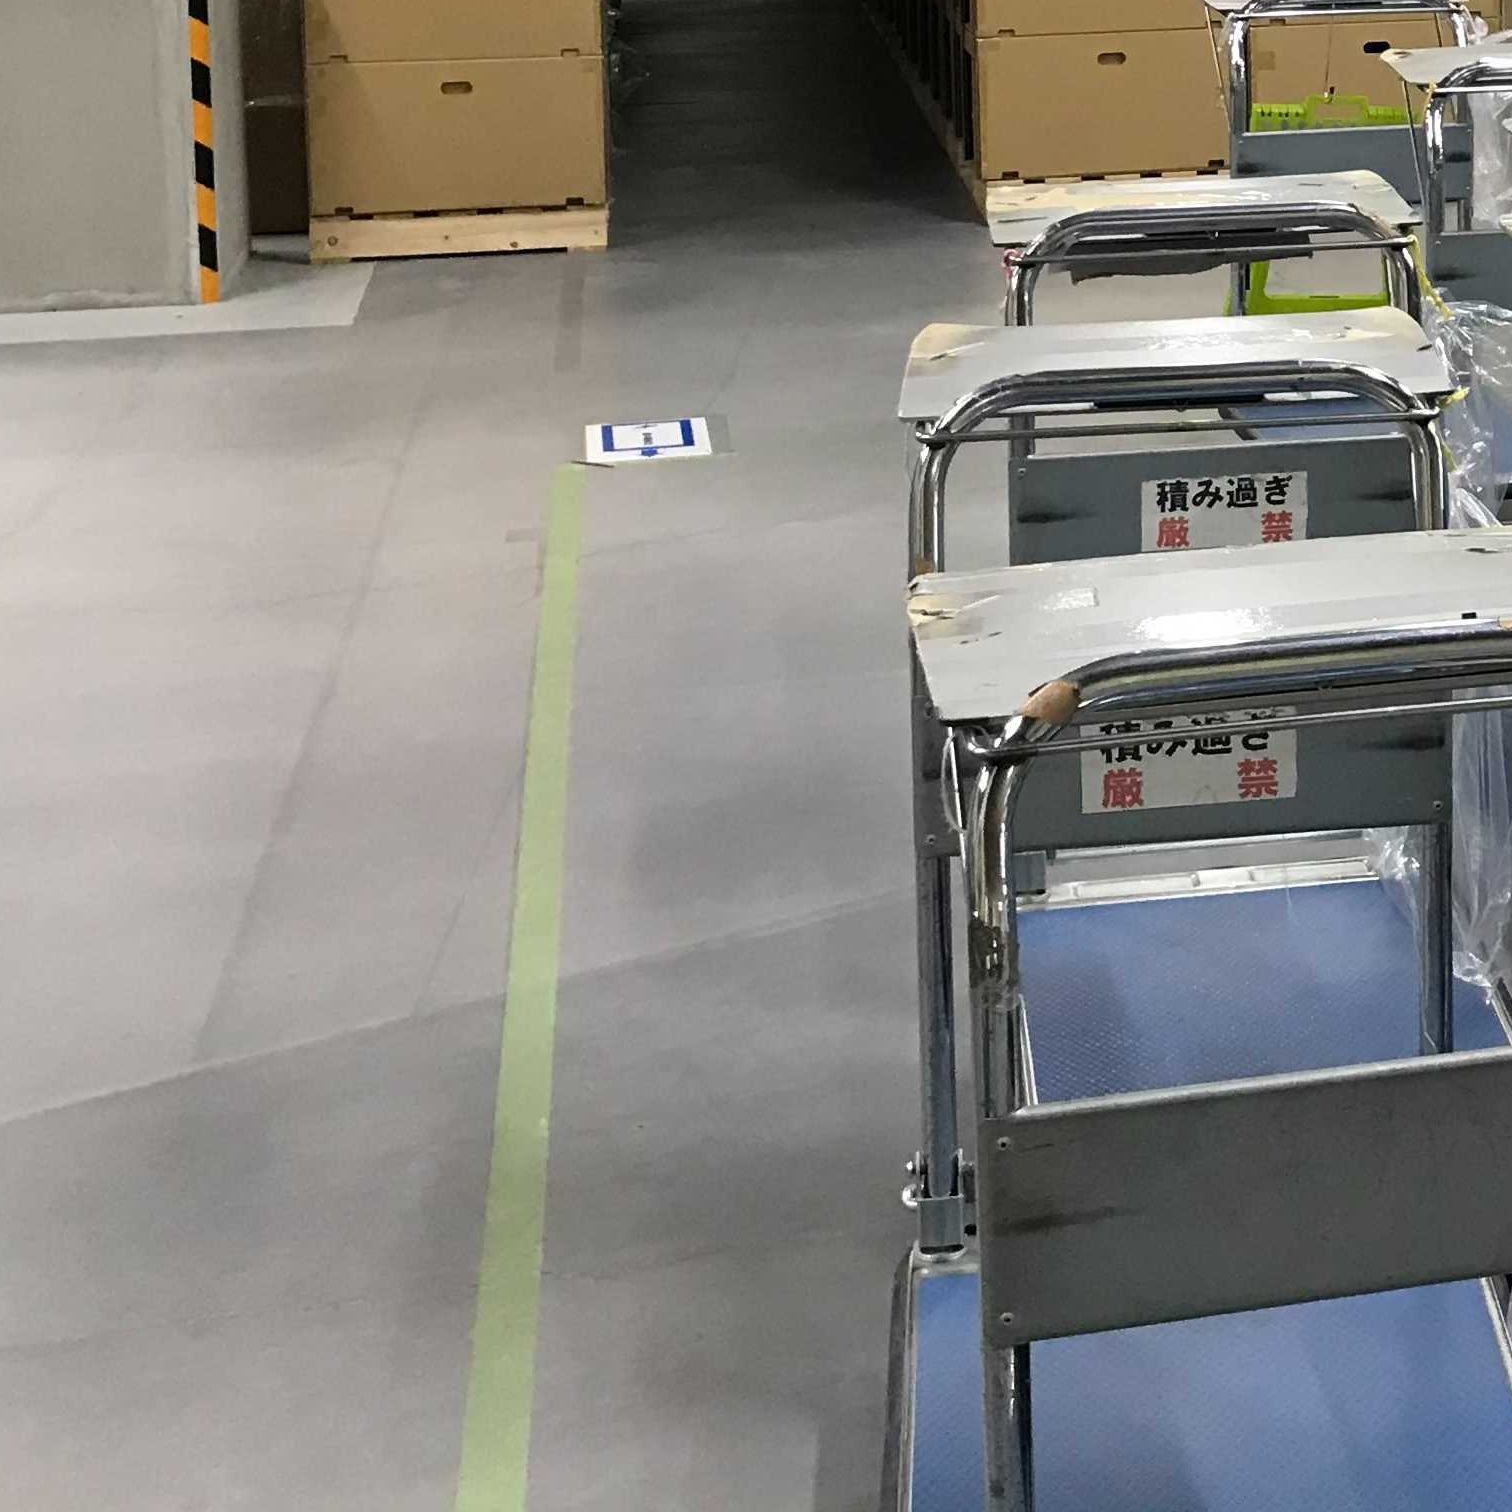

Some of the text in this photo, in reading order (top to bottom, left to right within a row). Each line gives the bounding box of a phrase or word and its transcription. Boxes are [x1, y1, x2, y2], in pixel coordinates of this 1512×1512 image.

[1156, 474, 1293, 514] 積み過ぎ
[1261, 510, 1293, 544] 禁
[1102, 757, 1278, 808] 厳 禁
